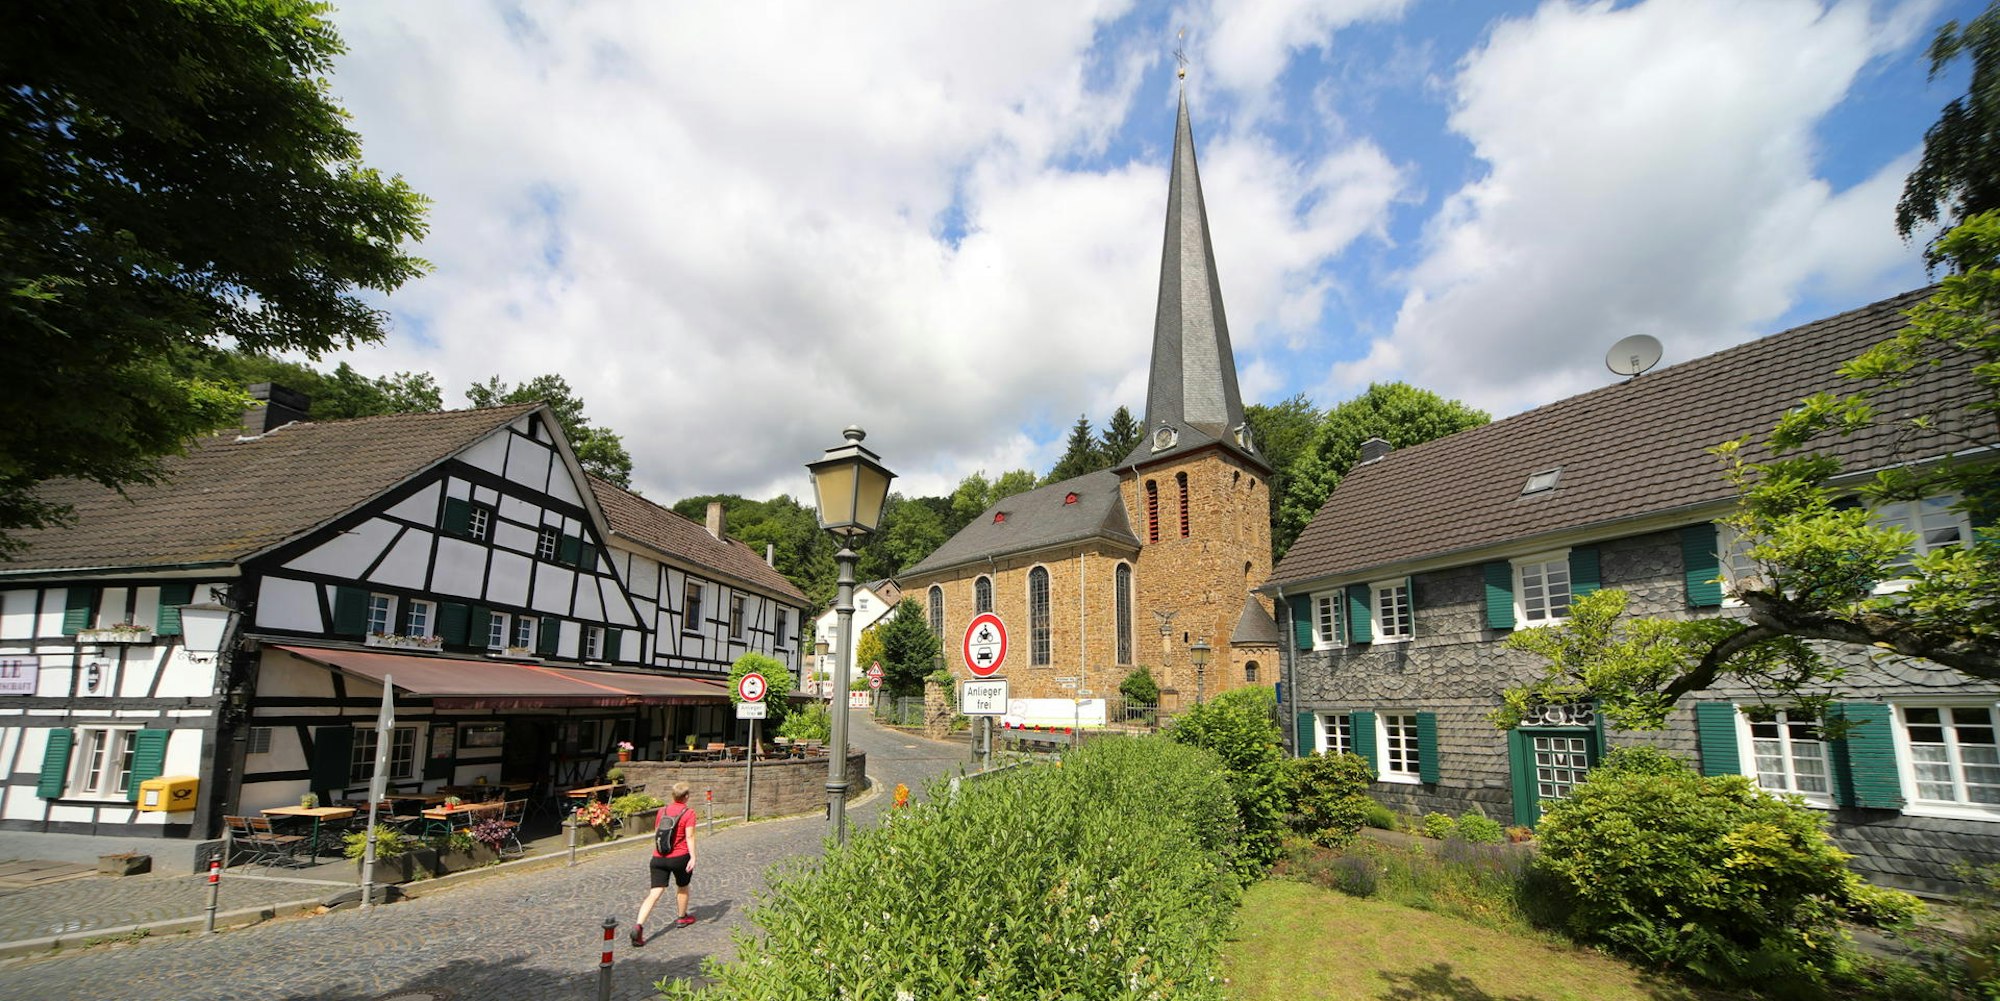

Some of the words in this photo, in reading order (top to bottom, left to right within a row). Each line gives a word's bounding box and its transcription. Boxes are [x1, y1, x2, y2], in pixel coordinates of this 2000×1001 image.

[1, 660, 22, 678] LE
[967, 686, 1002, 699] Anlieger
[977, 699, 992, 710] frei
